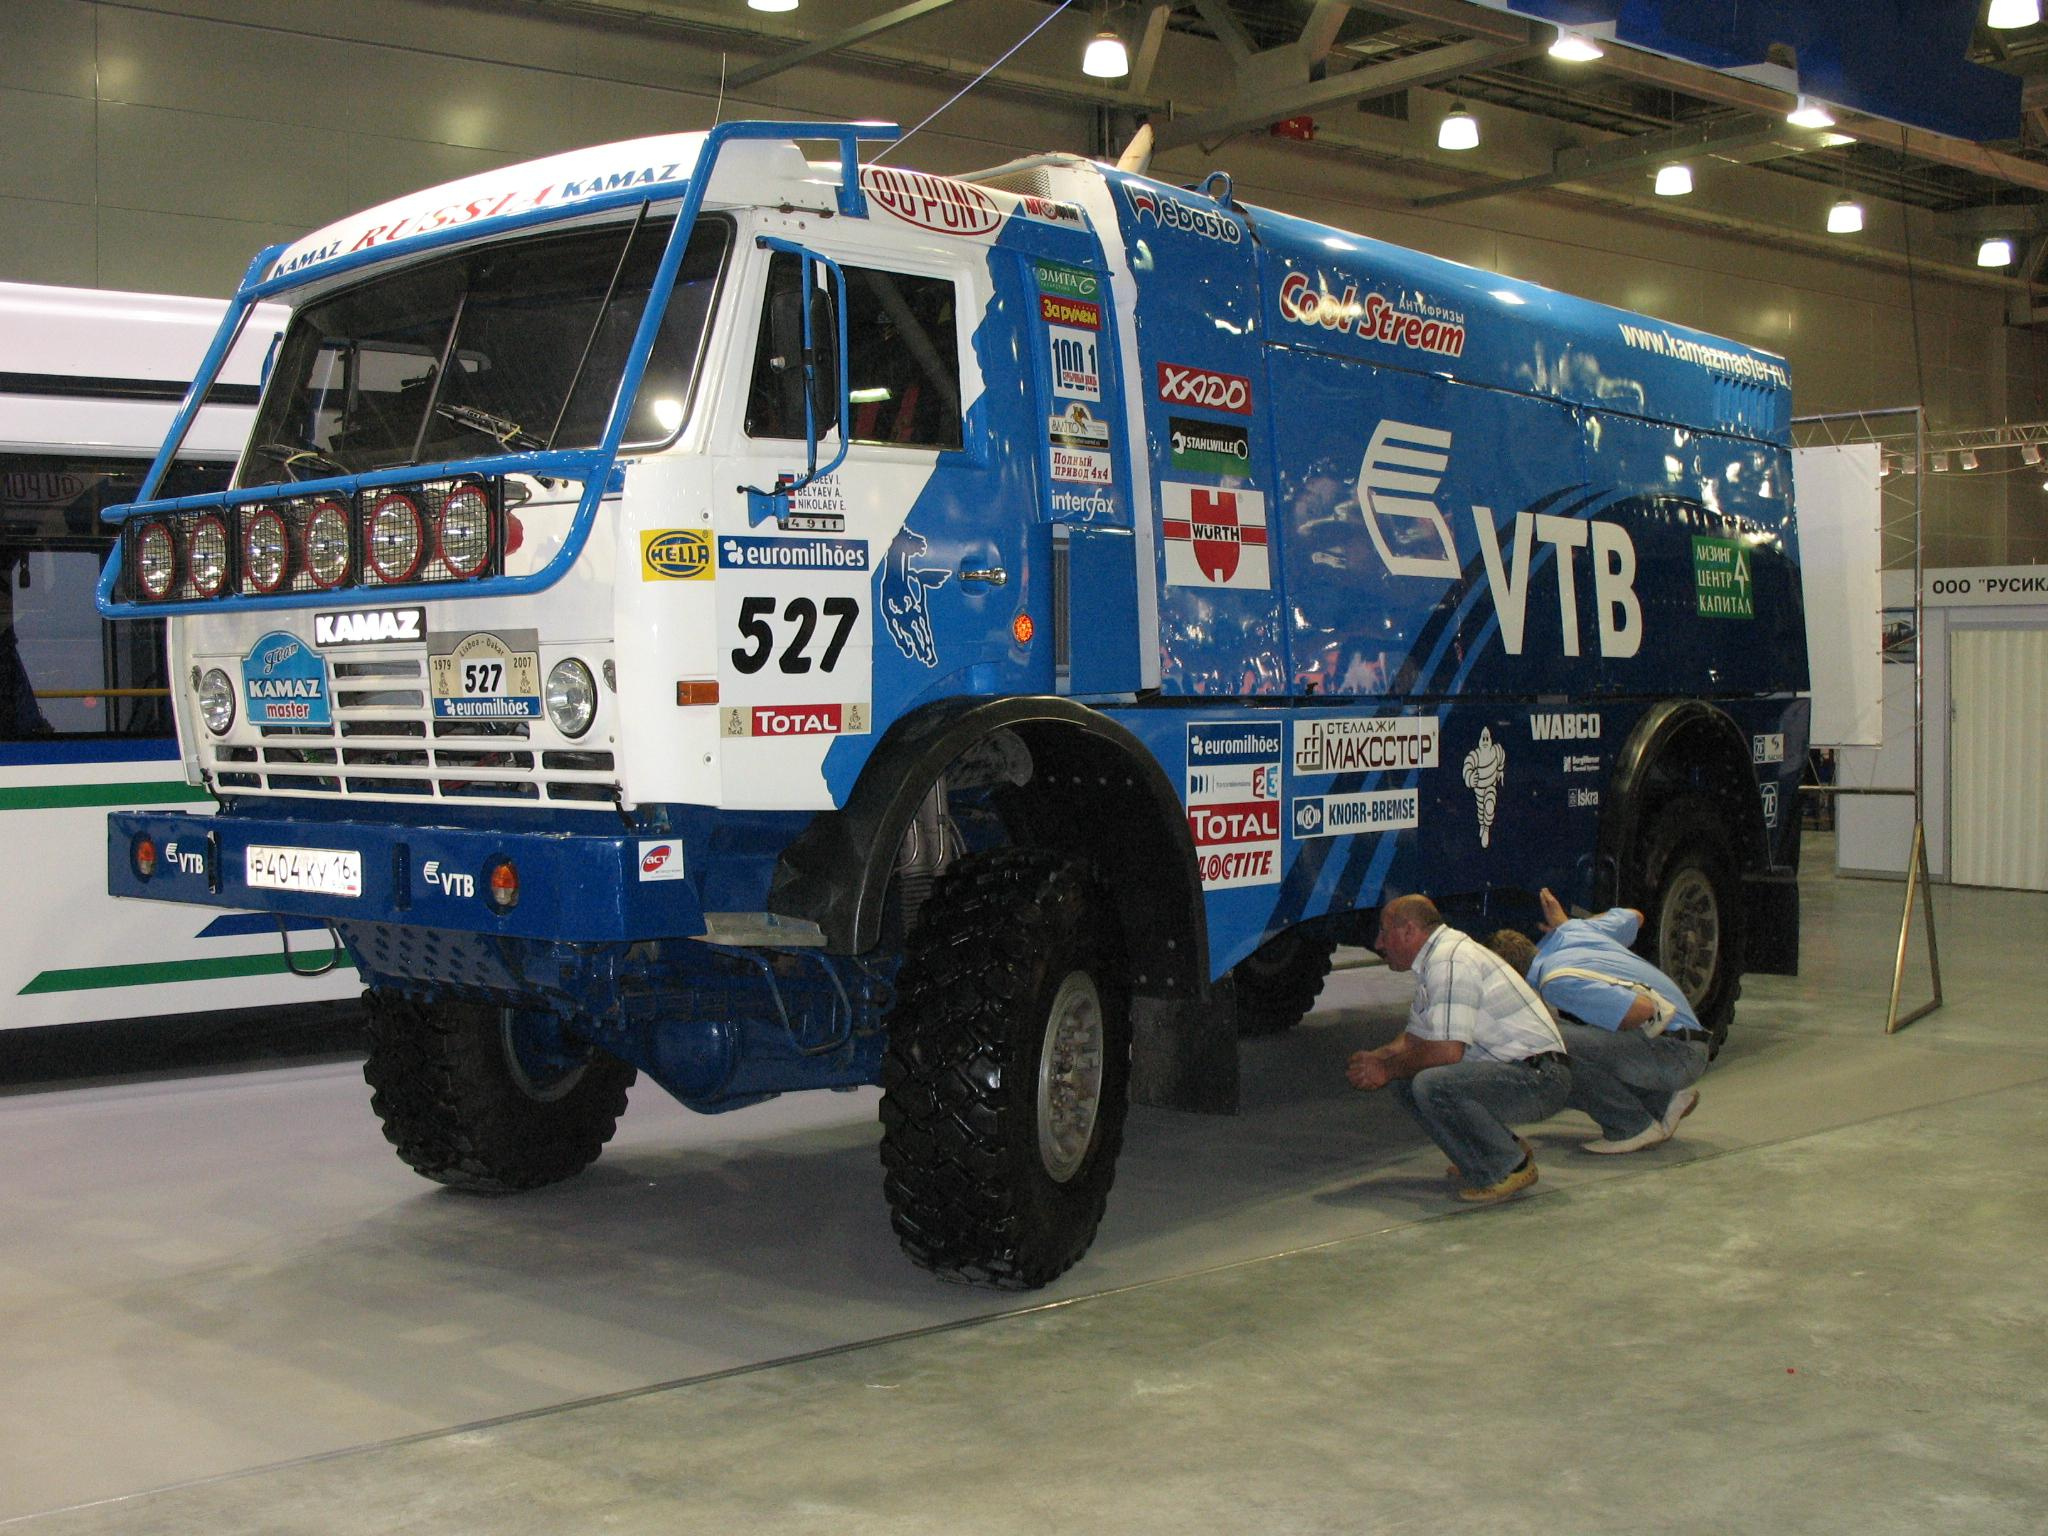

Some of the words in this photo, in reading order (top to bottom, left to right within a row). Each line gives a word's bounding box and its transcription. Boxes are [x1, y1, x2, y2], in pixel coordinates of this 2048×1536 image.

[274, 239, 342, 278] KAMAZ
[350, 183, 554, 252] RUSSIA
[561, 163, 680, 198] KAMAZ
[1124, 181, 1241, 244] Webasto
[1039, 267, 1078, 288] ЭЛИТА
[1399, 298, 1465, 324] АНТИФРИЗЫ
[1618, 323, 1787, 387] www.kamazmaster.ru
[1161, 367, 1247, 410] XADO
[1186, 435, 1234, 454] STAHLWILLE
[798, 498, 838, 511] NIKOLAEV
[840, 500, 847, 511] E.
[1051, 488, 1114, 521] interfax
[1192, 523, 1240, 541] WÜRTH
[651, 544, 709, 565] HELLA
[747, 541, 865, 567] euromilhões
[1696, 544, 1732, 564] ЛИЗИНГ
[1471, 505, 1643, 659] VTB
[1697, 569, 1733, 589] ЦЕНТР
[1932, 579, 1971, 594] ООО
[1978, 576, 2048, 593] "РУСИК
[1699, 594, 1752, 615] КАПИТАЛ
[315, 610, 420, 644] KAMAZ
[731, 596, 860, 675] 527
[433, 659, 452, 671] 1979
[513, 656, 532, 669] 2007
[248, 679, 322, 698] KAMAZ
[464, 663, 503, 693] 527
[266, 701, 309, 719] master
[456, 698, 529, 715] euromilhões
[1327, 720, 1397, 735] СТЕЛЛАЖИ
[1530, 713, 1600, 741] WABCO
[1205, 734, 1279, 755] euromilhões
[1326, 734, 1432, 770] МАКССТОР
[1329, 798, 1415, 826] KNORR-BREMSE
[179, 852, 204, 874] VTB
[441, 872, 475, 898] VTB
